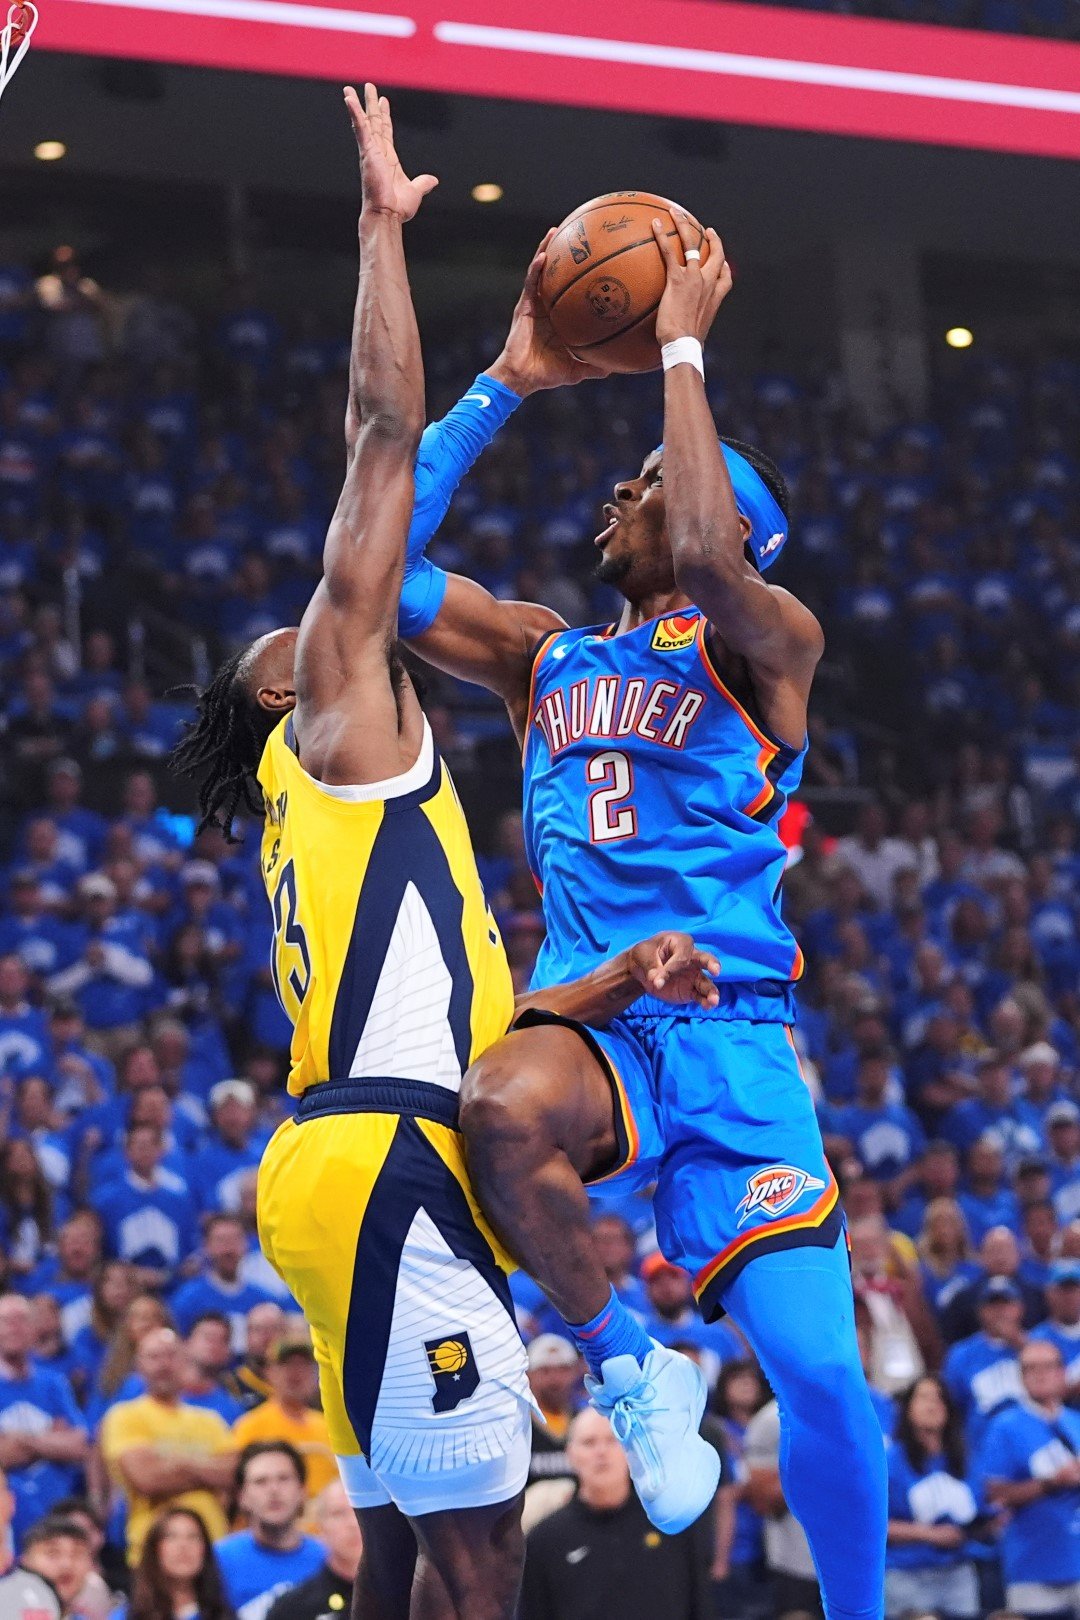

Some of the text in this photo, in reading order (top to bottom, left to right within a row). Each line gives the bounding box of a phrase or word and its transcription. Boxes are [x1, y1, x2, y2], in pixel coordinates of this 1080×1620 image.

[534, 676, 706, 757] THUNDER
[586, 750, 638, 844] 2
[746, 1177, 794, 1213] OKC
